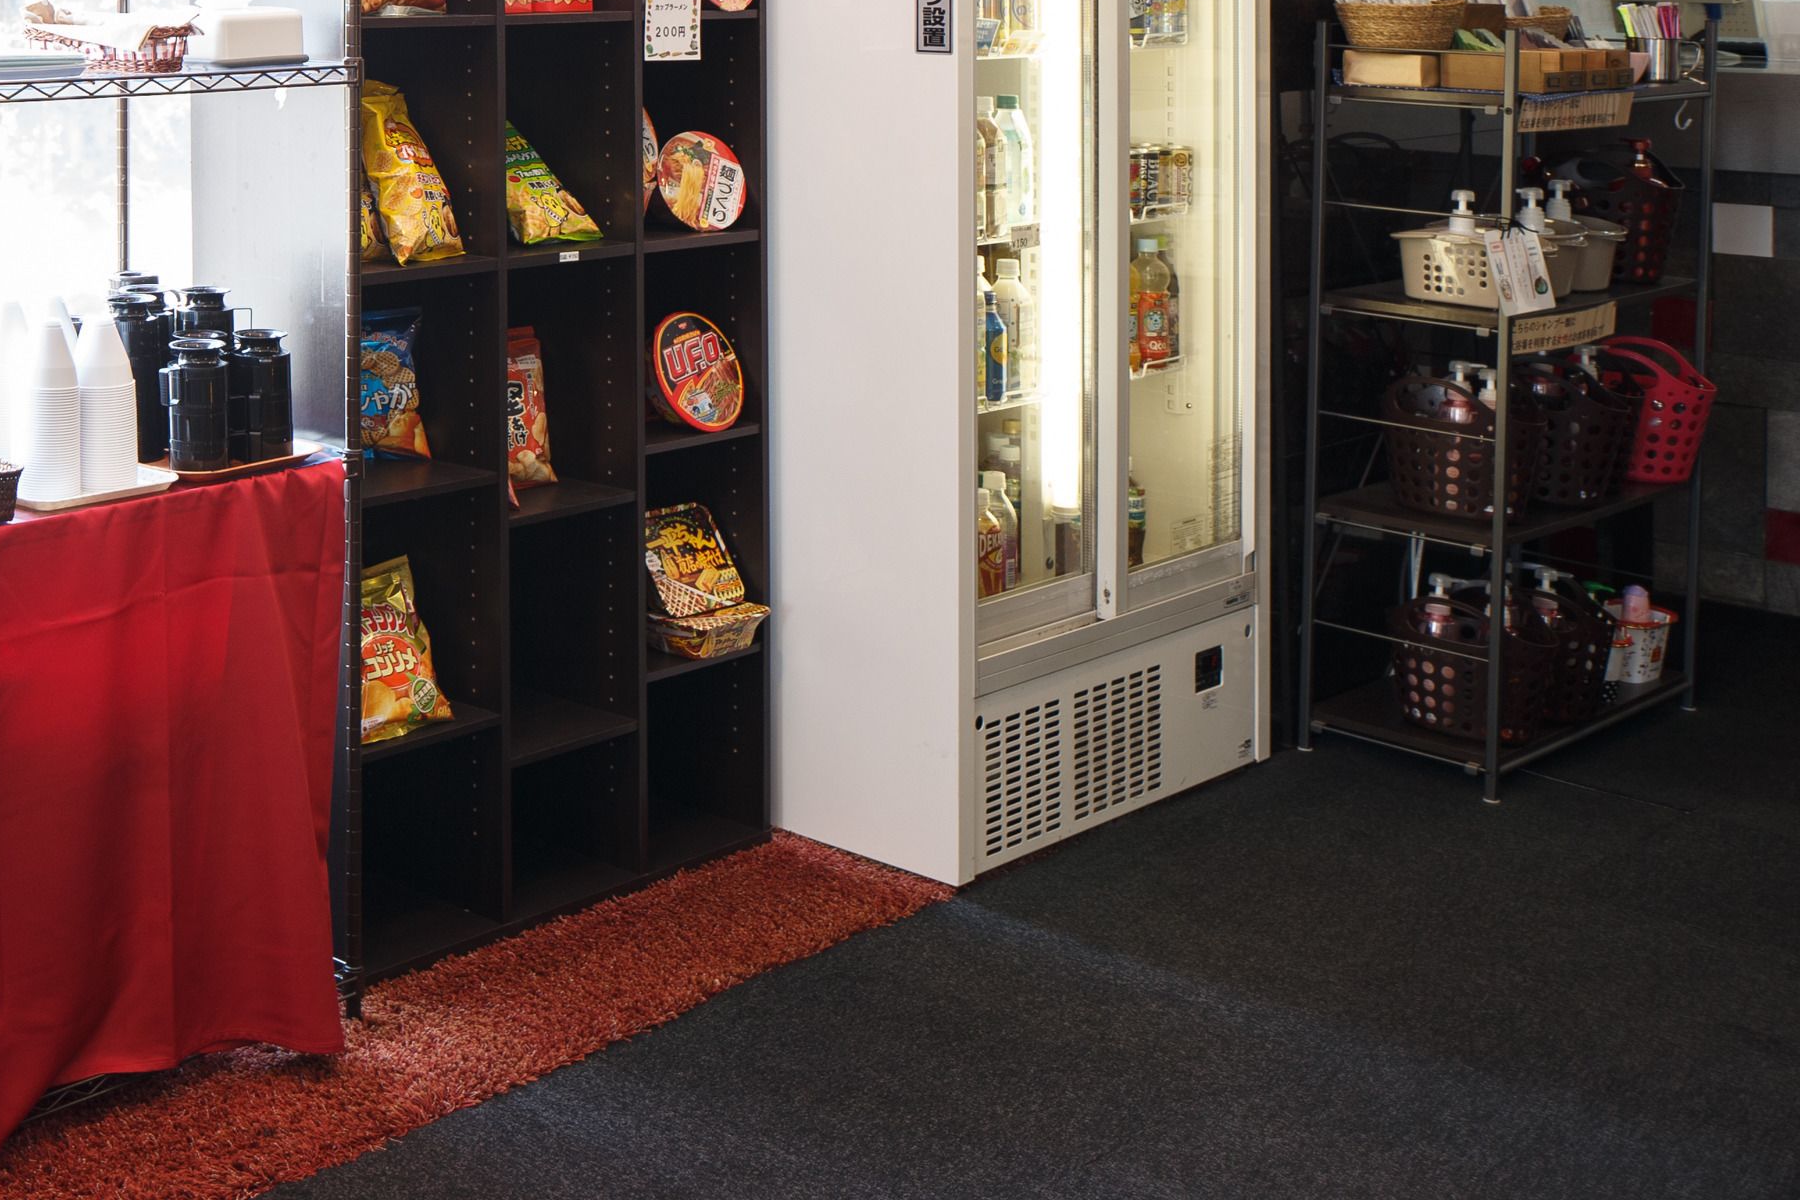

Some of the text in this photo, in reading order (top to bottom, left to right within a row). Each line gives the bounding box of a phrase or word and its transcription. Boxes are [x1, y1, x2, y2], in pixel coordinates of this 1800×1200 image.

[655, 26, 686, 38] 200円
[646, 522, 717, 556] 一平ちゃん
[374, 640, 395, 655] リッチ
[364, 647, 418, 680] コンソメ
